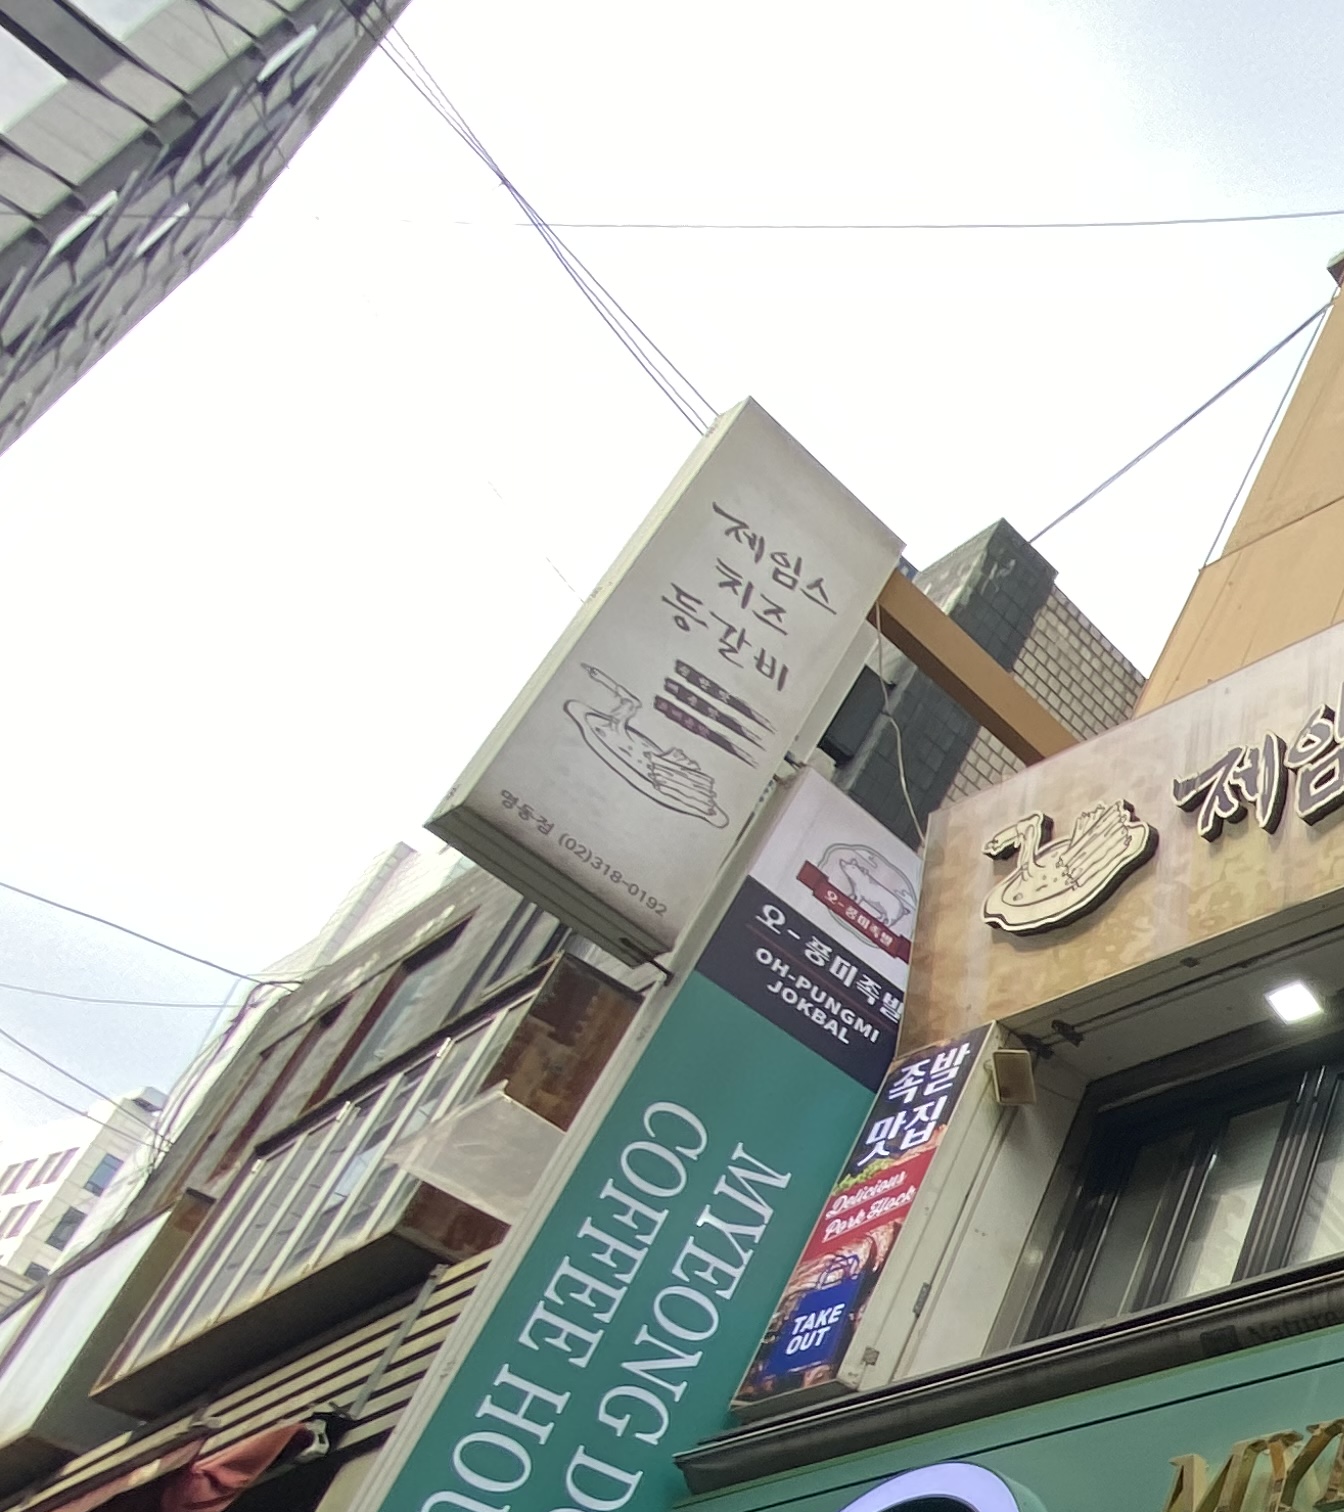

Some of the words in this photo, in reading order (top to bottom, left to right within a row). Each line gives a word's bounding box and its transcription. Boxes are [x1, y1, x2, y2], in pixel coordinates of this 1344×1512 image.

[712, 502, 838, 616] 제임스
[714, 557, 789, 636] 치즈
[660, 583, 790, 692] 등갈비
[500, 788, 557, 838] 명동점
[557, 830, 669, 918] (02)318-0192
[755, 947, 880, 1044] OH-PUNGMI
[767, 978, 850, 1045] JOKBAL
[888, 1042, 970, 1103] 족발
[857, 1096, 948, 1167] 맛집
[518, 1099, 709, 1369] COFFEE
[825, 1170, 908, 1221] Delicious
[599, 1142, 791, 1447] MYEONG
[793, 1303, 845, 1335] TAKE
[785, 1326, 831, 1355] OUT
